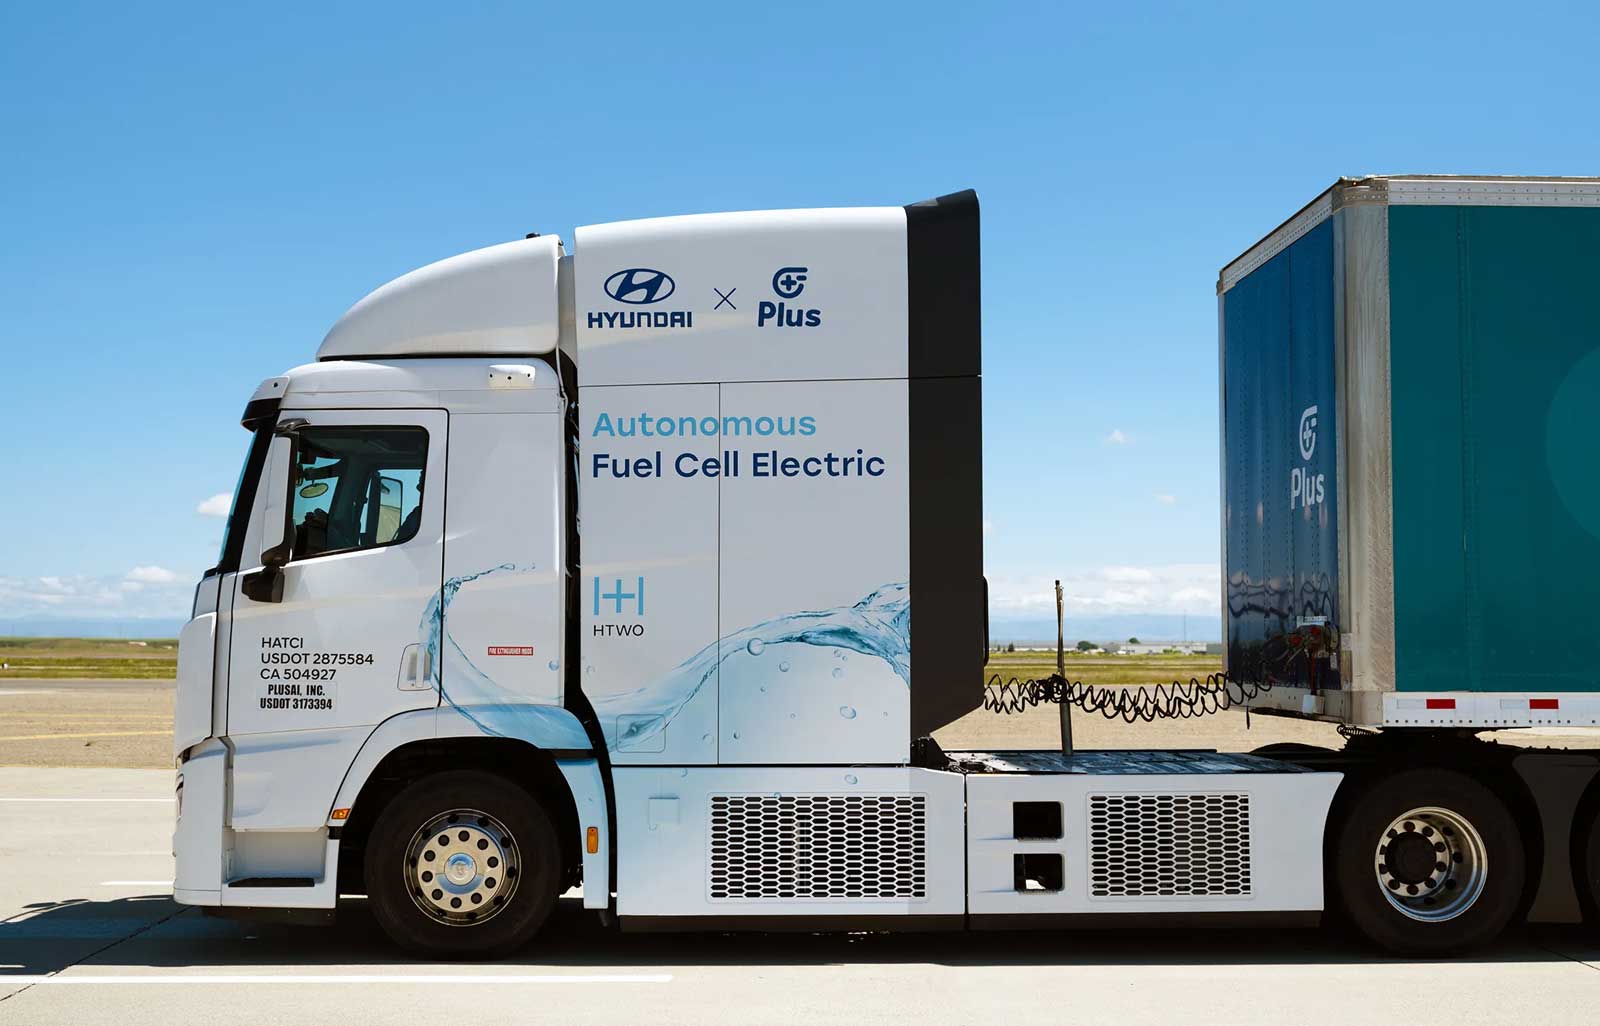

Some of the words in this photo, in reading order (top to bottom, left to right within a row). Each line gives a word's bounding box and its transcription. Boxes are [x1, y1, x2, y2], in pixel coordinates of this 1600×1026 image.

[587, 312, 693, 329] HYUNDAI
[757, 301, 822, 328] Plus
[591, 412, 817, 438] Autonomous
[592, 451, 662, 478] Fuel
[674, 450, 740, 478] Cell
[752, 448, 886, 478] Electric
[1290, 467, 1325, 510] Plus
[593, 624, 644, 637] HTWO
[261, 637, 304, 649] HATCI
[261, 652, 311, 665] USDOT
[312, 653, 374, 665] 2875584
[260, 668, 281, 680] CA
[283, 668, 337, 681] 504927
[306, 684, 326, 697] INC.
[260, 698, 291, 710] USDOT
[292, 698, 333, 711] 3173394
